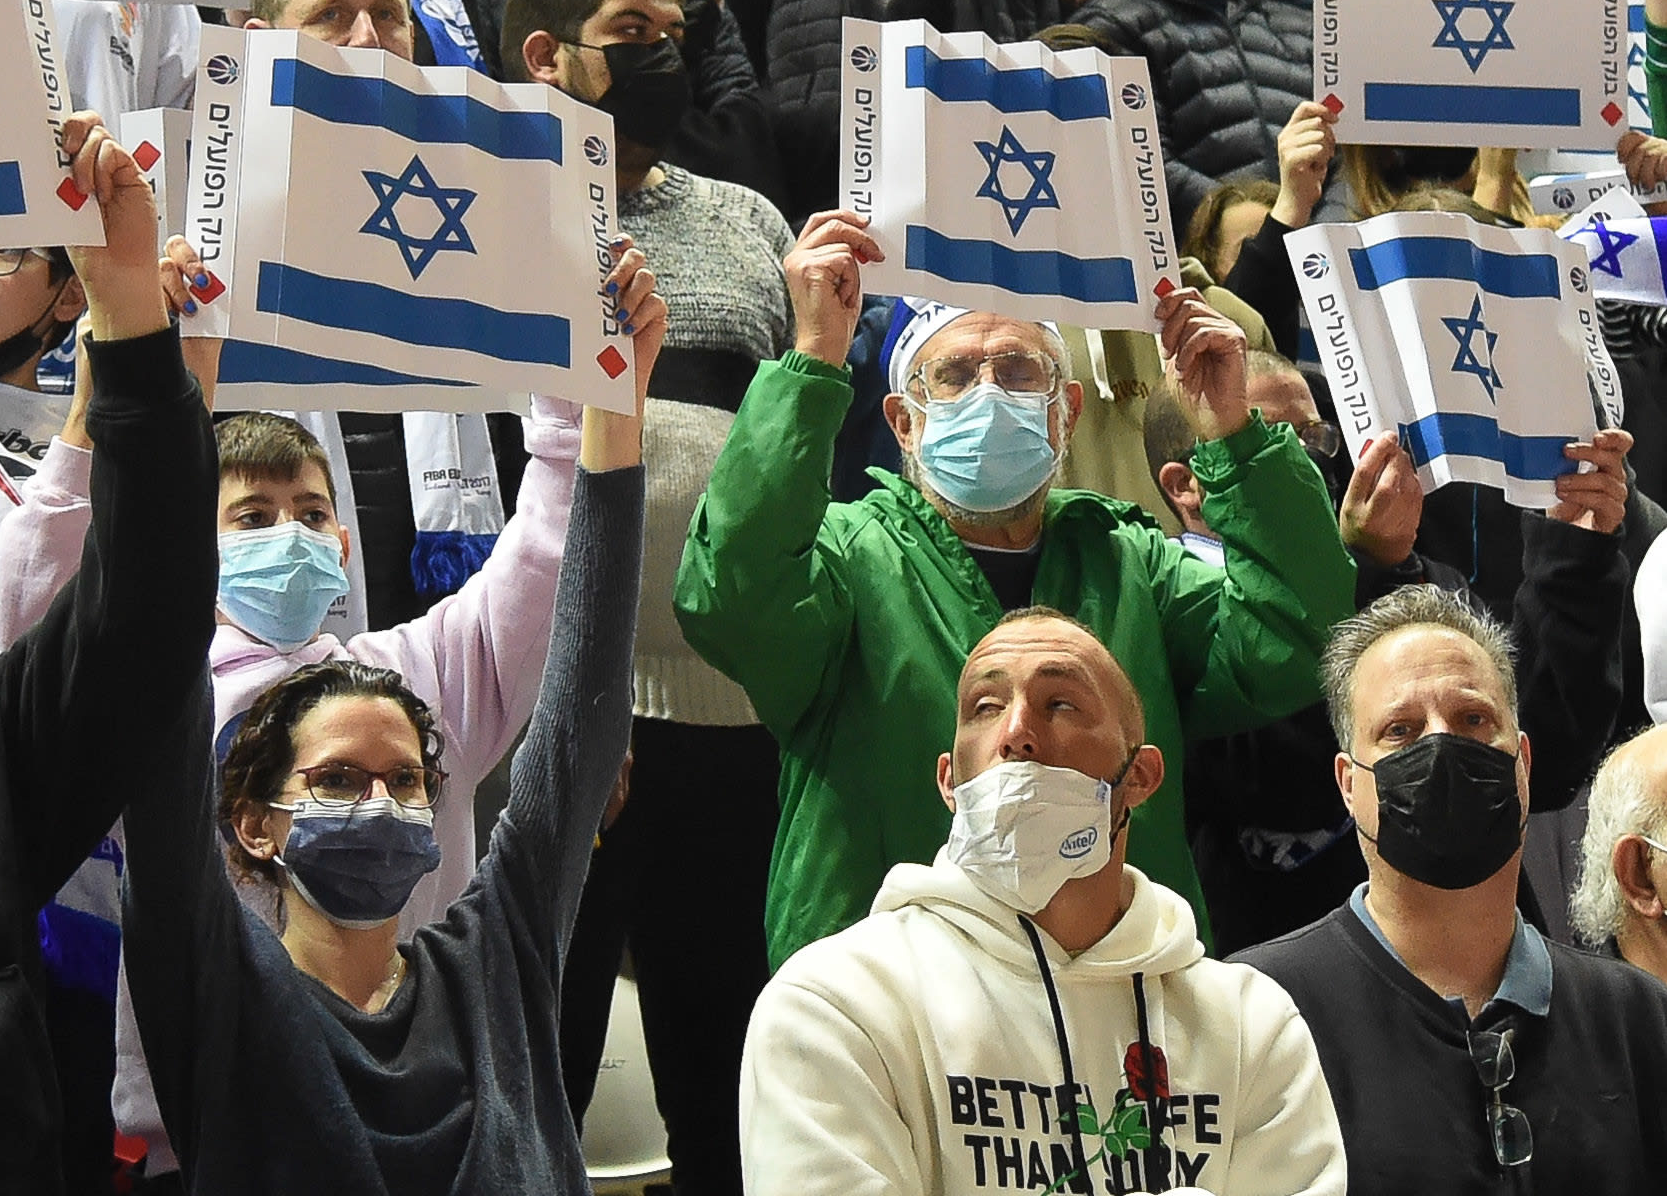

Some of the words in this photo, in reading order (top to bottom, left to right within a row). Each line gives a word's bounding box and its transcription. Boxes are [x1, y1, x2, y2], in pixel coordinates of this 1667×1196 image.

[1320, 53, 1339, 88] בנק
[1600, 61, 1618, 96] בנק
[203, 103, 234, 210] הפועלים
[854, 88, 877, 183] הפועלים
[1131, 127, 1160, 224] הפועלים
[849, 190, 872, 225] נק
[197, 218, 222, 263] בנק
[1143, 230, 1169, 271] בנק
[1317, 293, 1359, 392] הפועלים
[1343, 391, 1372, 435] בנק
[423, 469, 447, 484] FIBA
[946, 1074, 1100, 1136] BETTE
